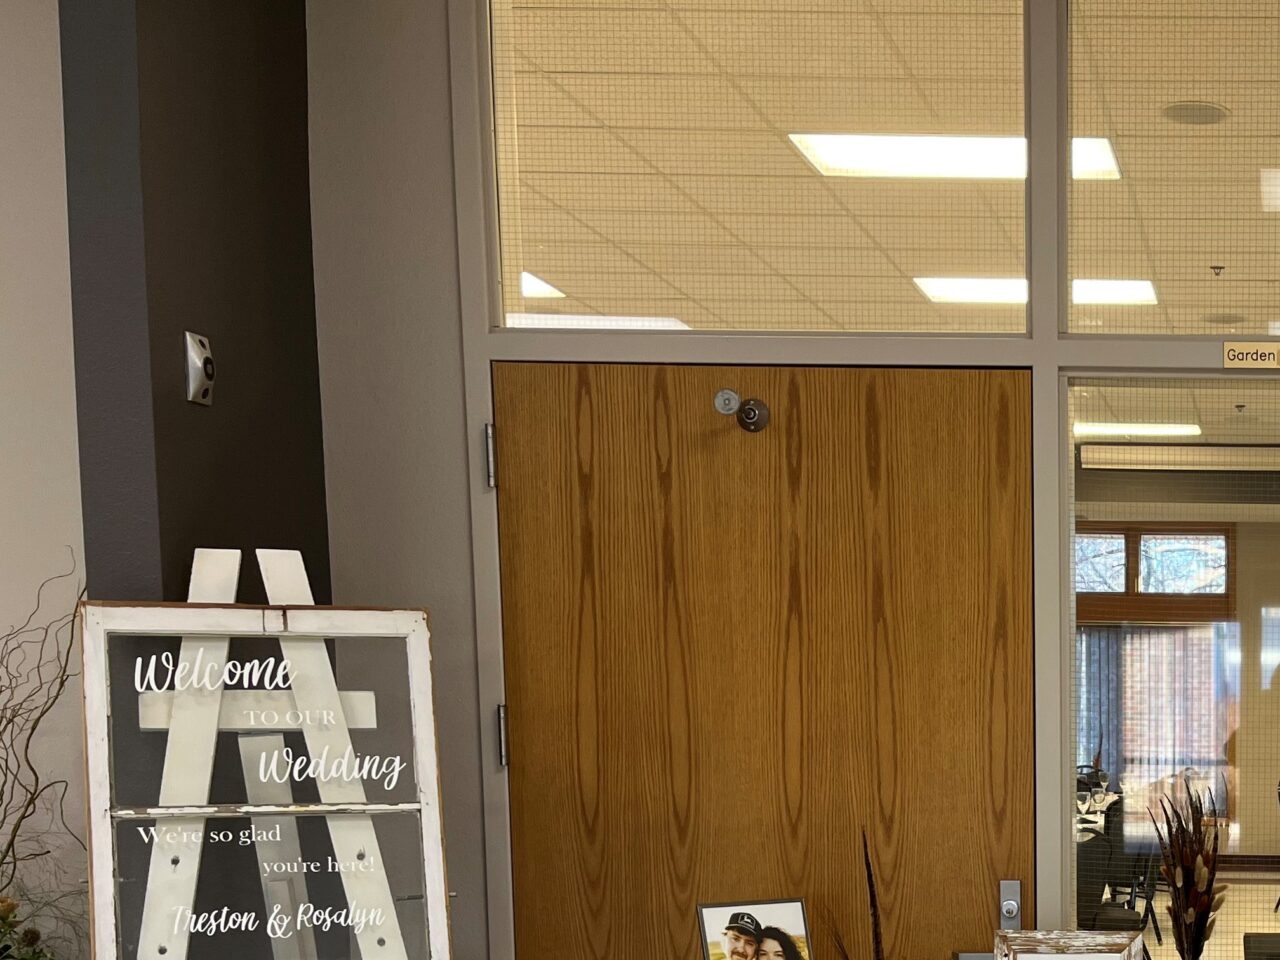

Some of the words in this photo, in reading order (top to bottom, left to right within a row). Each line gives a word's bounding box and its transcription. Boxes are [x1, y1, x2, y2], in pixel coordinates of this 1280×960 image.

[1227, 349, 1275, 361] Garden
[134, 647, 297, 693] Welcome
[243, 709, 278, 726] TO
[286, 709, 336, 726] OUR
[258, 745, 406, 790] Wedding
[137, 826, 202, 845] We're
[210, 830, 233, 843] so
[238, 825, 281, 846] glad
[263, 857, 321, 876] you're
[327, 857, 375, 873] here!
[172, 905, 259, 936] Treston
[266, 904, 293, 939] &
[296, 900, 386, 934] Rosalyn
